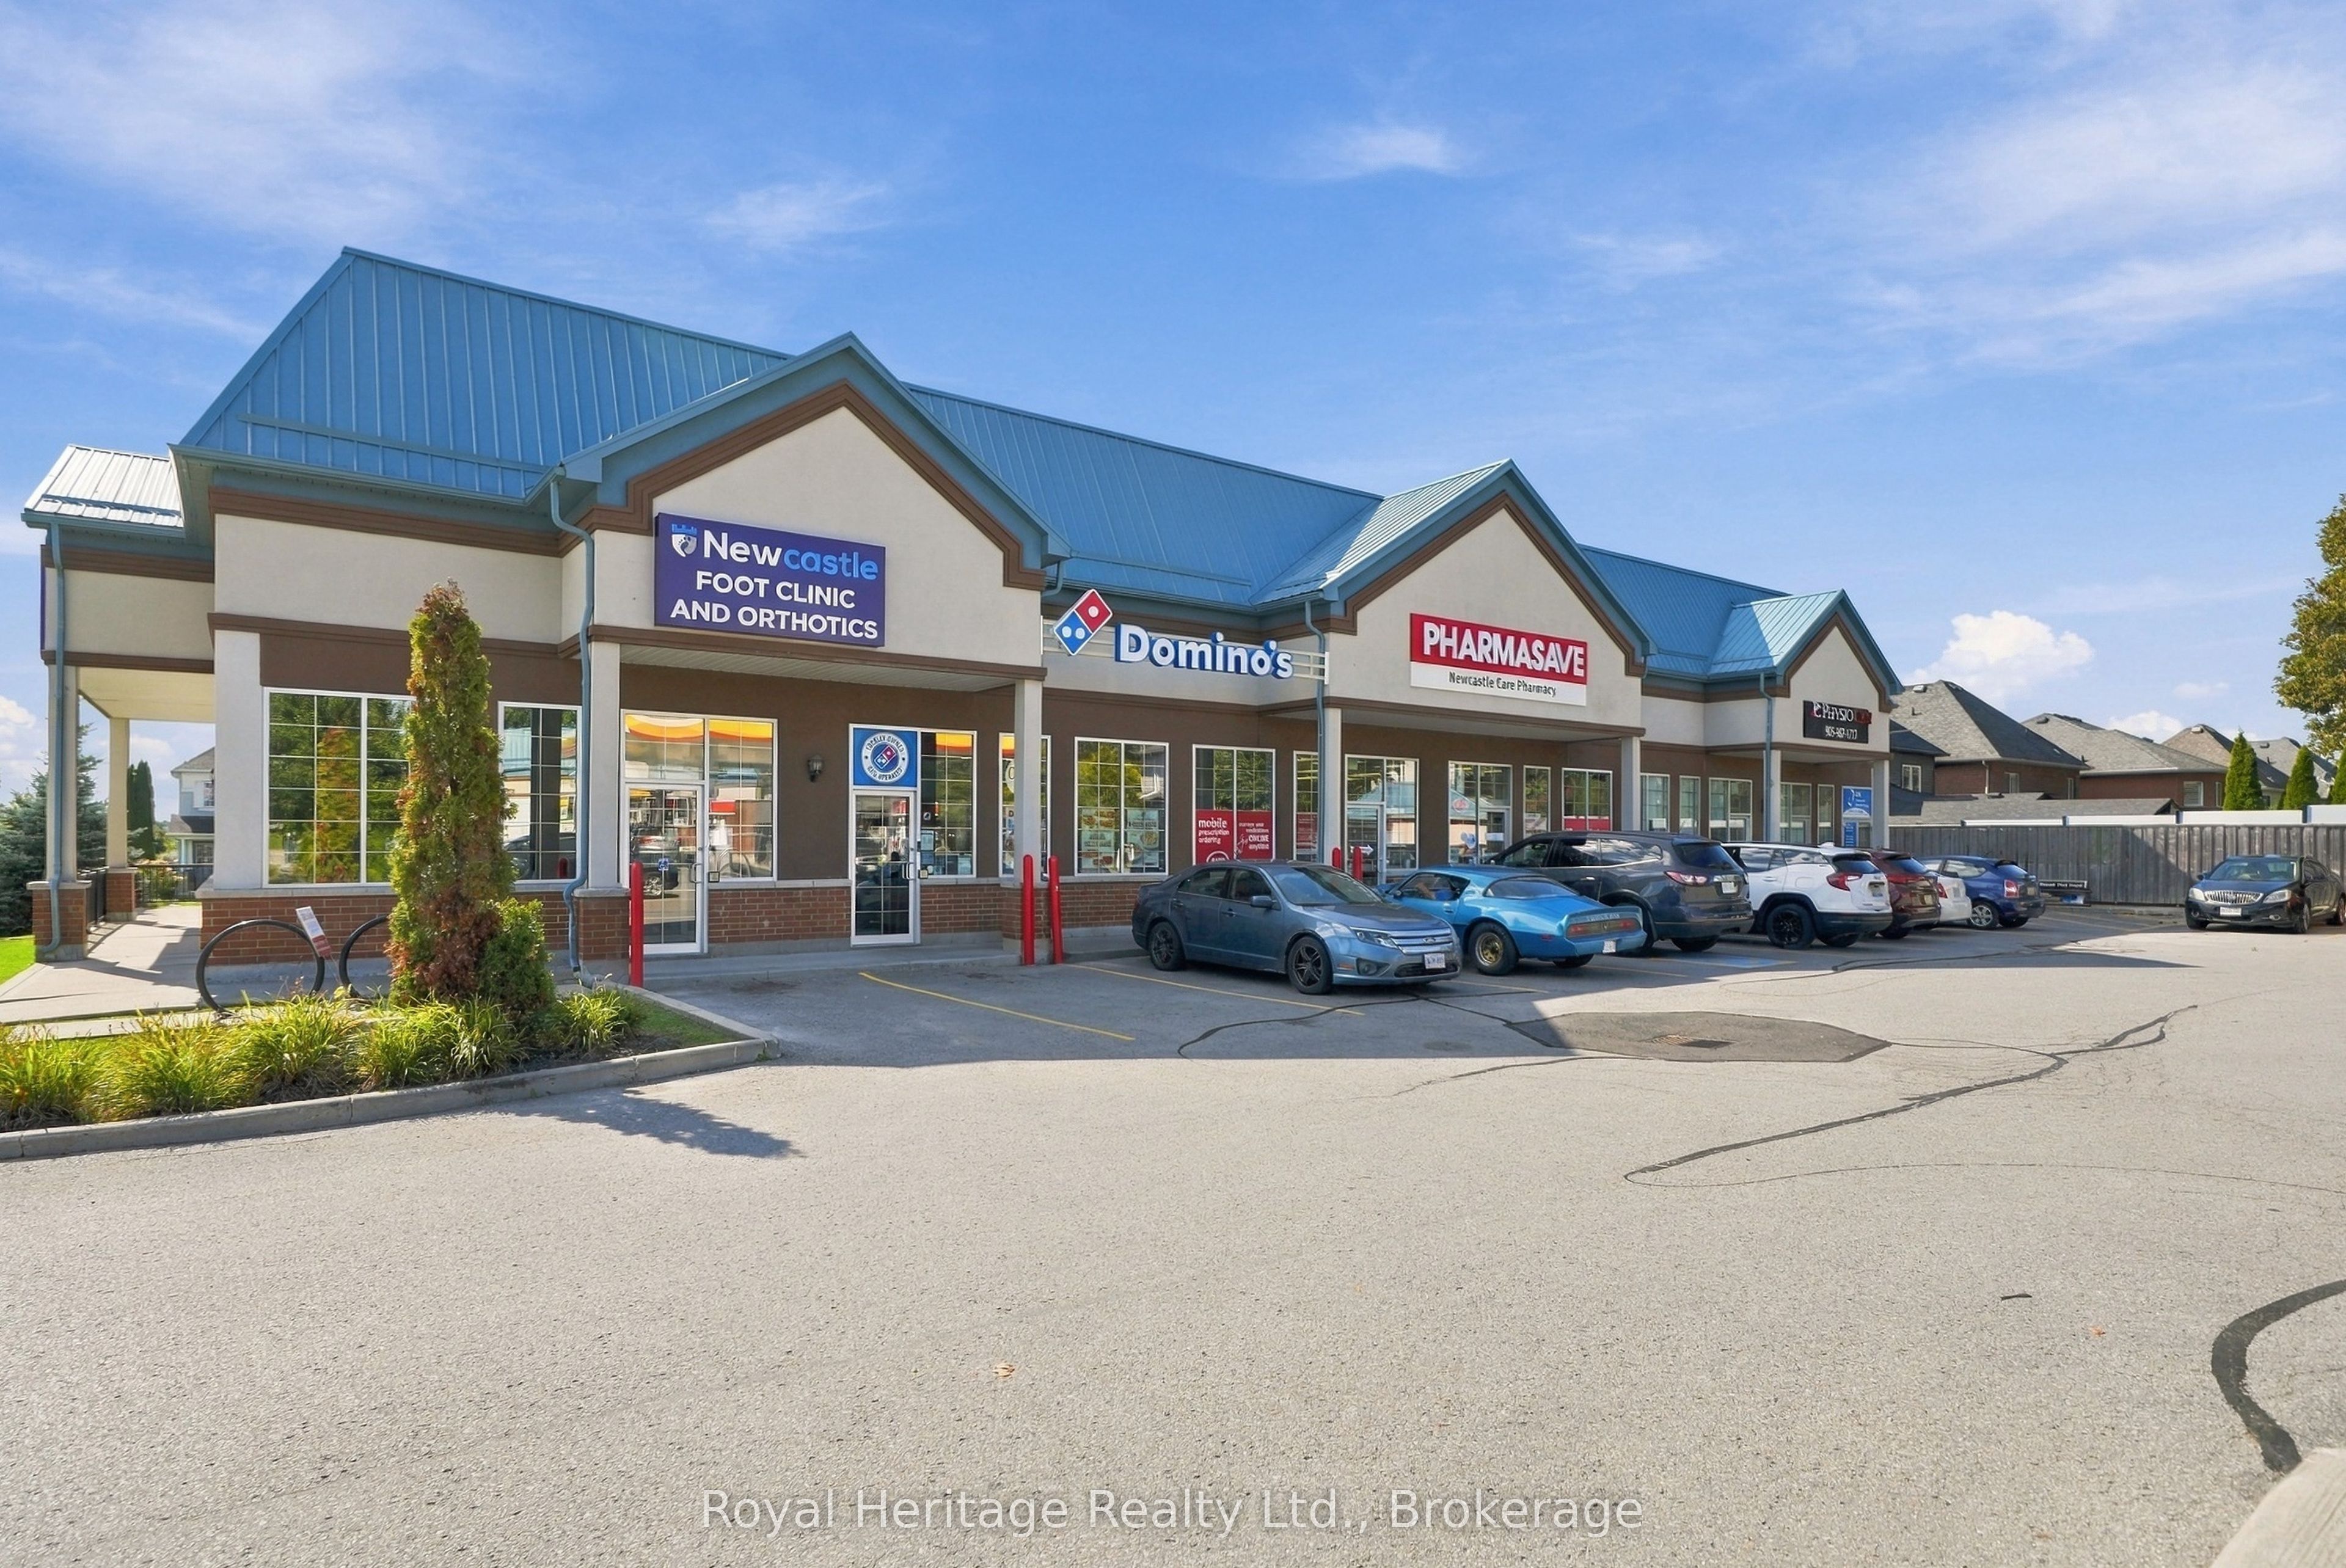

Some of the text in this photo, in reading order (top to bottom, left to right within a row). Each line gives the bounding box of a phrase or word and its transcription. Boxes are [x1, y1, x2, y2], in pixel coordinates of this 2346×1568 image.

[704, 530, 879, 580] Newcastle
[696, 570, 855, 608] FOOT CLINIC
[670, 599, 878, 640] AND ORTHOTICS
[1116, 623, 1293, 679] Domino's
[1423, 621, 1584, 677] PHARMASAVE
[1449, 671, 1556, 697] Newcastle Care Pharmacy
[865, 735, 904, 753] LOCALLY OWNED
[1198, 817, 1227, 828] mobile
